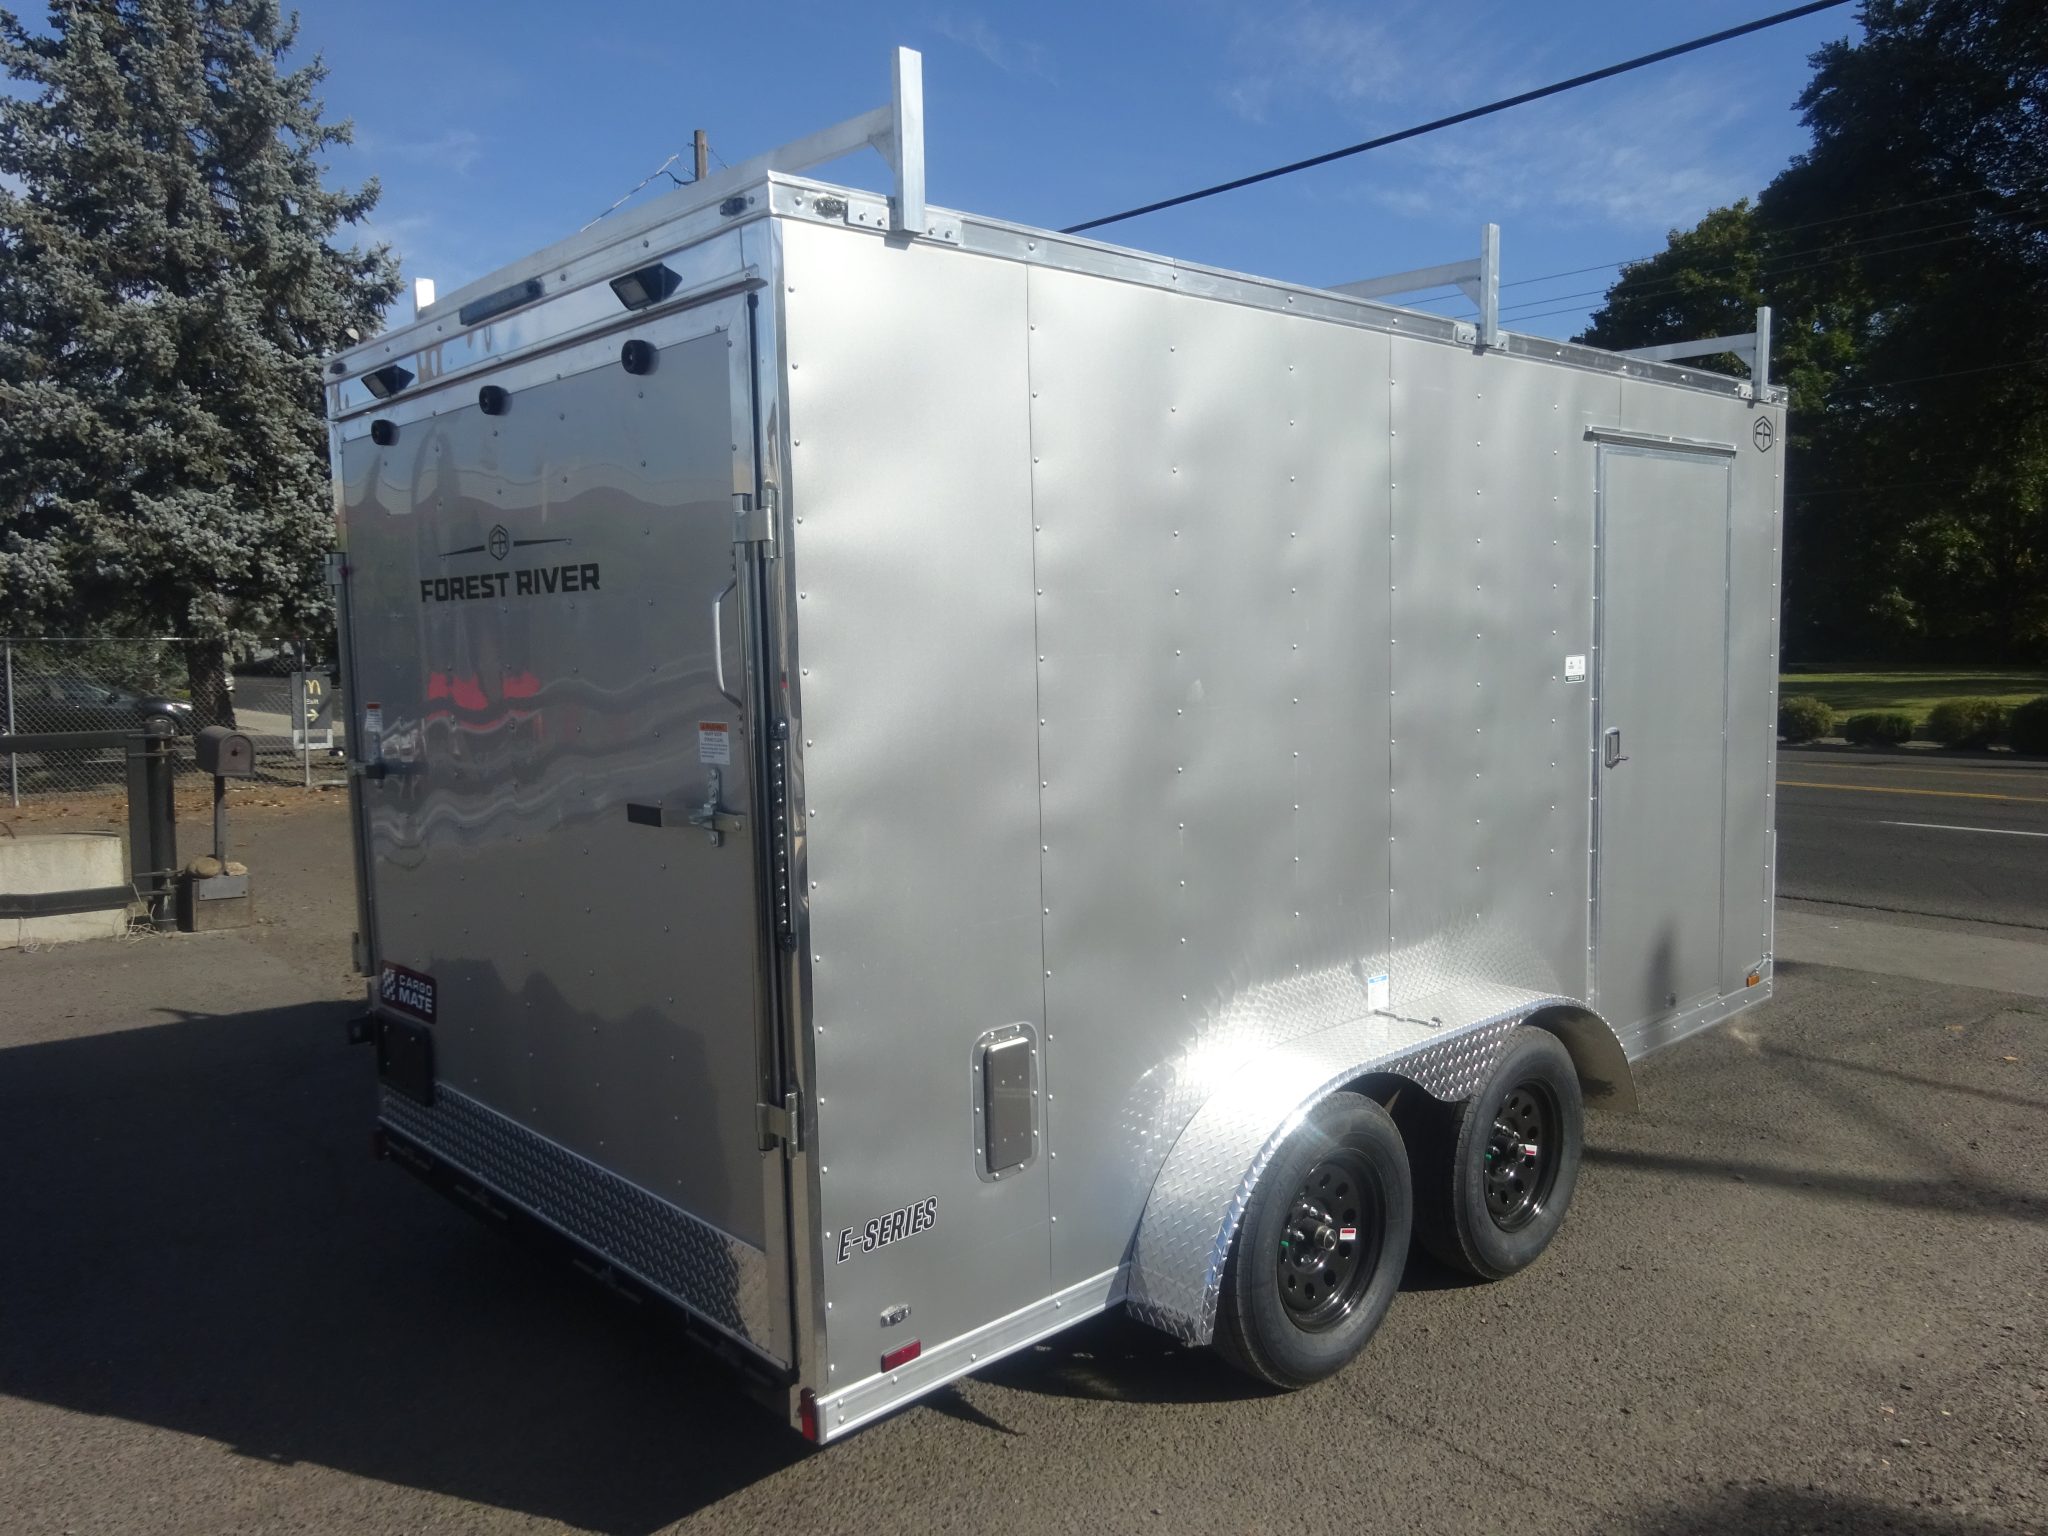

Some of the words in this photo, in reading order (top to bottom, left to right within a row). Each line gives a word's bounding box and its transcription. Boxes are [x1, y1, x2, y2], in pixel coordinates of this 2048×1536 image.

[420, 572, 510, 603] FOREST
[515, 563, 601, 596] RIVER
[399, 975, 432, 996] CARGO
[399, 987, 432, 1013] MATE
[836, 1196, 938, 1264] E-SERIES
